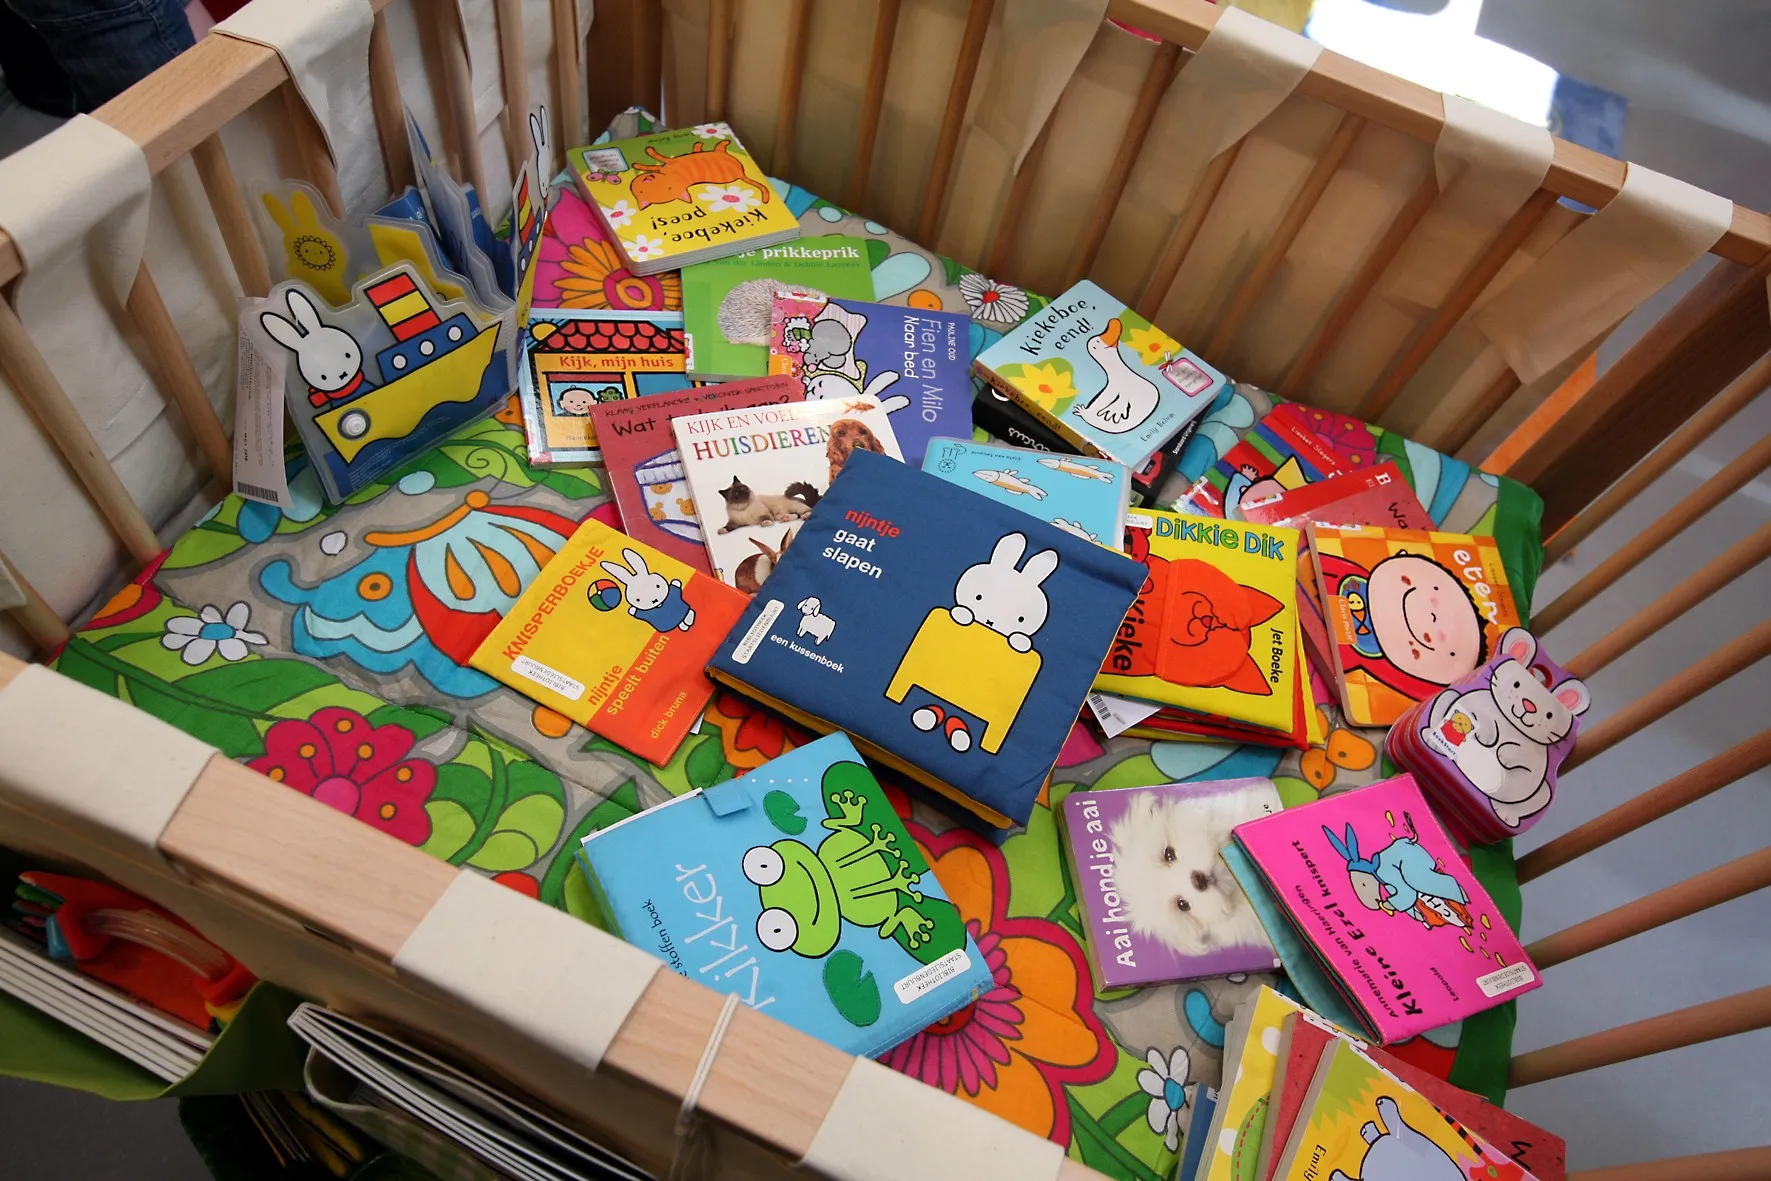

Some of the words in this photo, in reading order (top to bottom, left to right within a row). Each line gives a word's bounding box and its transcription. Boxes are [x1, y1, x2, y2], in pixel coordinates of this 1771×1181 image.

[650, 206, 706, 230] poes!
[663, 208, 768, 242] Kiekeboe,
[763, 246, 860, 260] prikkeprik
[904, 315, 920, 349] Naar
[921, 318, 942, 352] Fien
[947, 322, 956, 346] PAULINE
[1019, 300, 1096, 356] Kiekeboe,
[1054, 317, 1095, 351] eend!
[560, 356, 598, 370] Kijk,
[601, 356, 637, 370] mijn
[641, 356, 674, 367] huis
[904, 351, 920, 379] bed
[921, 358, 938, 380] en
[948, 347, 956, 360] OUD
[921, 385, 943, 423] Milo
[612, 416, 656, 437] Wat
[686, 418, 723, 435] KIJK
[728, 415, 751, 429] EN
[753, 408, 798, 425] VOEL
[1139, 426, 1157, 442] Emily
[692, 424, 832, 460] HUISDIEREN
[1313, 446, 1336, 467] Slegers
[1375, 472, 1392, 485] B
[844, 507, 902, 539] nijntje
[1156, 516, 1240, 550] Dikkie
[1244, 531, 1285, 561] Dik
[833, 528, 876, 553] gaat
[822, 546, 883, 579] slapen
[502, 546, 604, 661] KNISPERBOEKJE
[1453, 549, 1499, 625] eten
[770, 633, 788, 647] een
[788, 641, 845, 673] kussenboek
[1271, 627, 1283, 646] Jet
[521, 658, 580, 689] STAATSLIEDENBUURT
[606, 674, 642, 715] speelt
[635, 634, 670, 674] buiten
[1270, 647, 1283, 683] Boeke
[587, 664, 624, 707] nijntje
[650, 713, 668, 739] dick
[664, 690, 687, 718] bruna
[1075, 799, 1103, 834] aai
[1090, 838, 1125, 923] hondje
[1291, 839, 1332, 899] knispert
[641, 898, 662, 929] boek
[1295, 884, 1336, 936] Haeringen
[1324, 902, 1366, 941] Ezel
[658, 927, 684, 970] stoffen
[1105, 928, 1137, 968] Aai
[1335, 936, 1352, 957] van
[900, 951, 963, 991] STAATSLIEDENBUURT
[915, 966, 957, 993] BIBLIOTHEEK
[1365, 946, 1423, 1016] Kleine
[1429, 967, 1460, 1002] Leopold
[1352, 958, 1399, 1019] Annemarie
